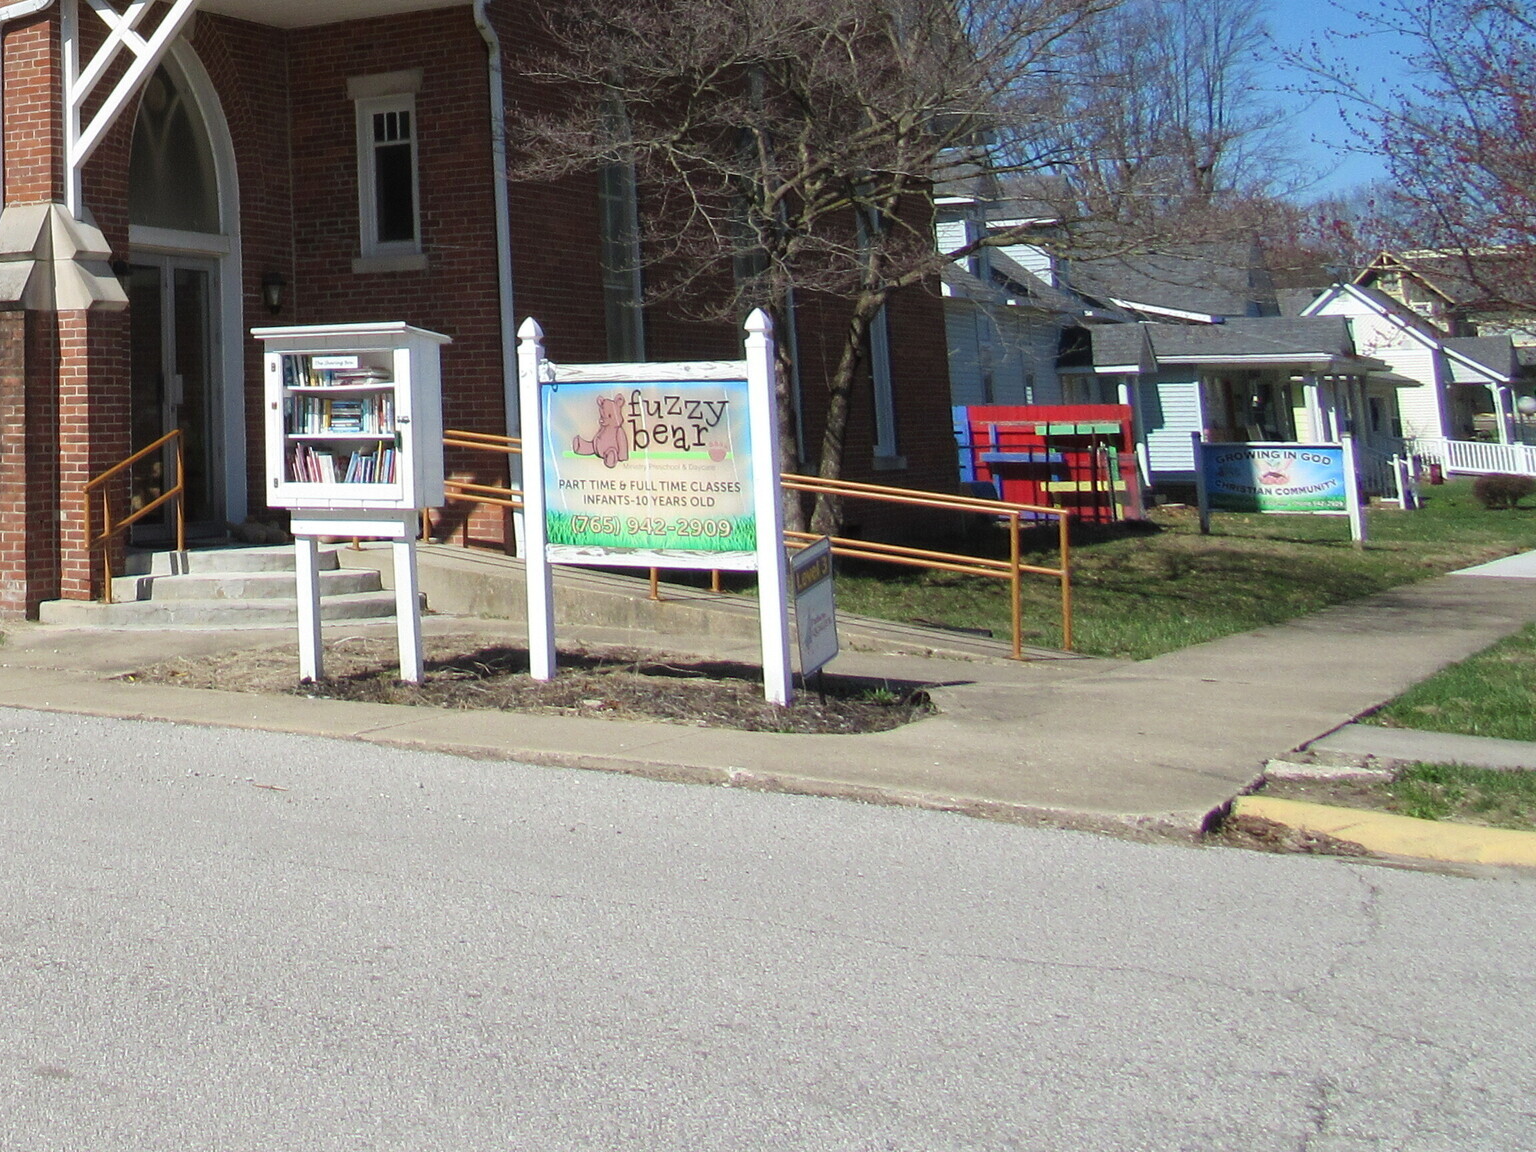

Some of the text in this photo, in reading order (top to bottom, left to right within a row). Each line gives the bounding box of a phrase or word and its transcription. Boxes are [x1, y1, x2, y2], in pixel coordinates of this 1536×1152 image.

[627, 389, 730, 428] fuzzy
[627, 419, 709, 452] bear
[1215, 450, 1332, 466] GROWING IN GOD
[623, 463, 647, 472] Ministry
[649, 463, 681, 471] Preschool
[689, 464, 716, 472] Daycare
[558, 479, 741, 493] PART TIME & FULL TIME CLASSES
[1215, 478, 1337, 496] CHRISTIAN COMMUNITY
[583, 494, 716, 508] INFANTS-10 YEARS OLD
[571, 515, 733, 538] (765) 942-2909
